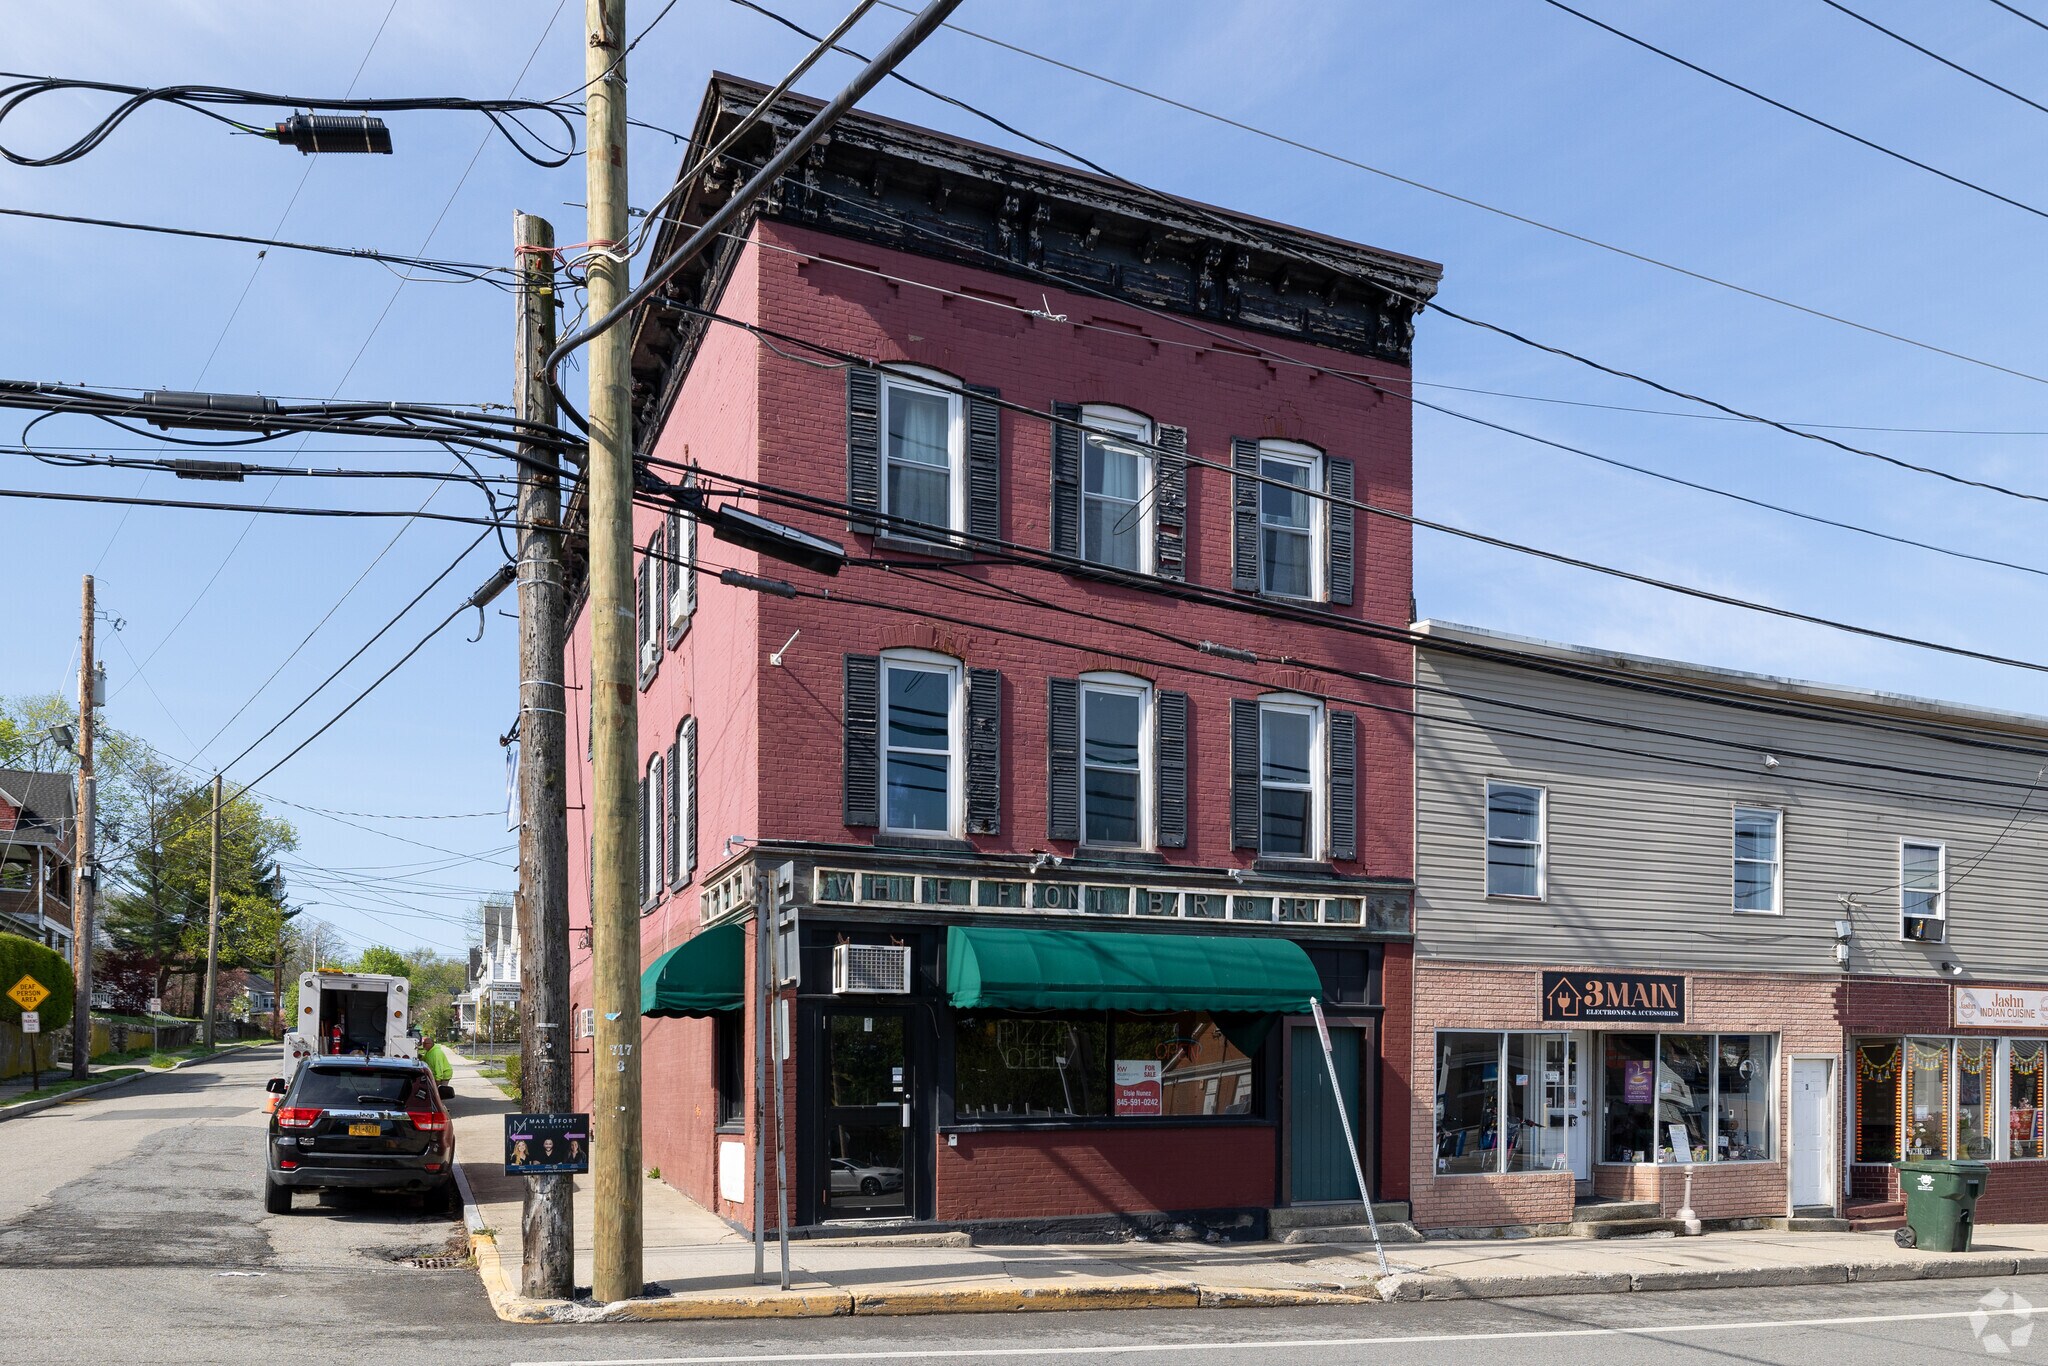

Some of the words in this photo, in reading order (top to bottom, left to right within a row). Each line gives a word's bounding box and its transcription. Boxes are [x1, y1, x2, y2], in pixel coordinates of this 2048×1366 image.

[1992, 992, 2024, 1008] Jashn
[1980, 1008, 2006, 1017] INDIAN
[2007, 1008, 2036, 1018] CUISINE
[609, 1044, 632, 1056] 717
[1116, 1098, 1158, 1106] 845-591-0242
